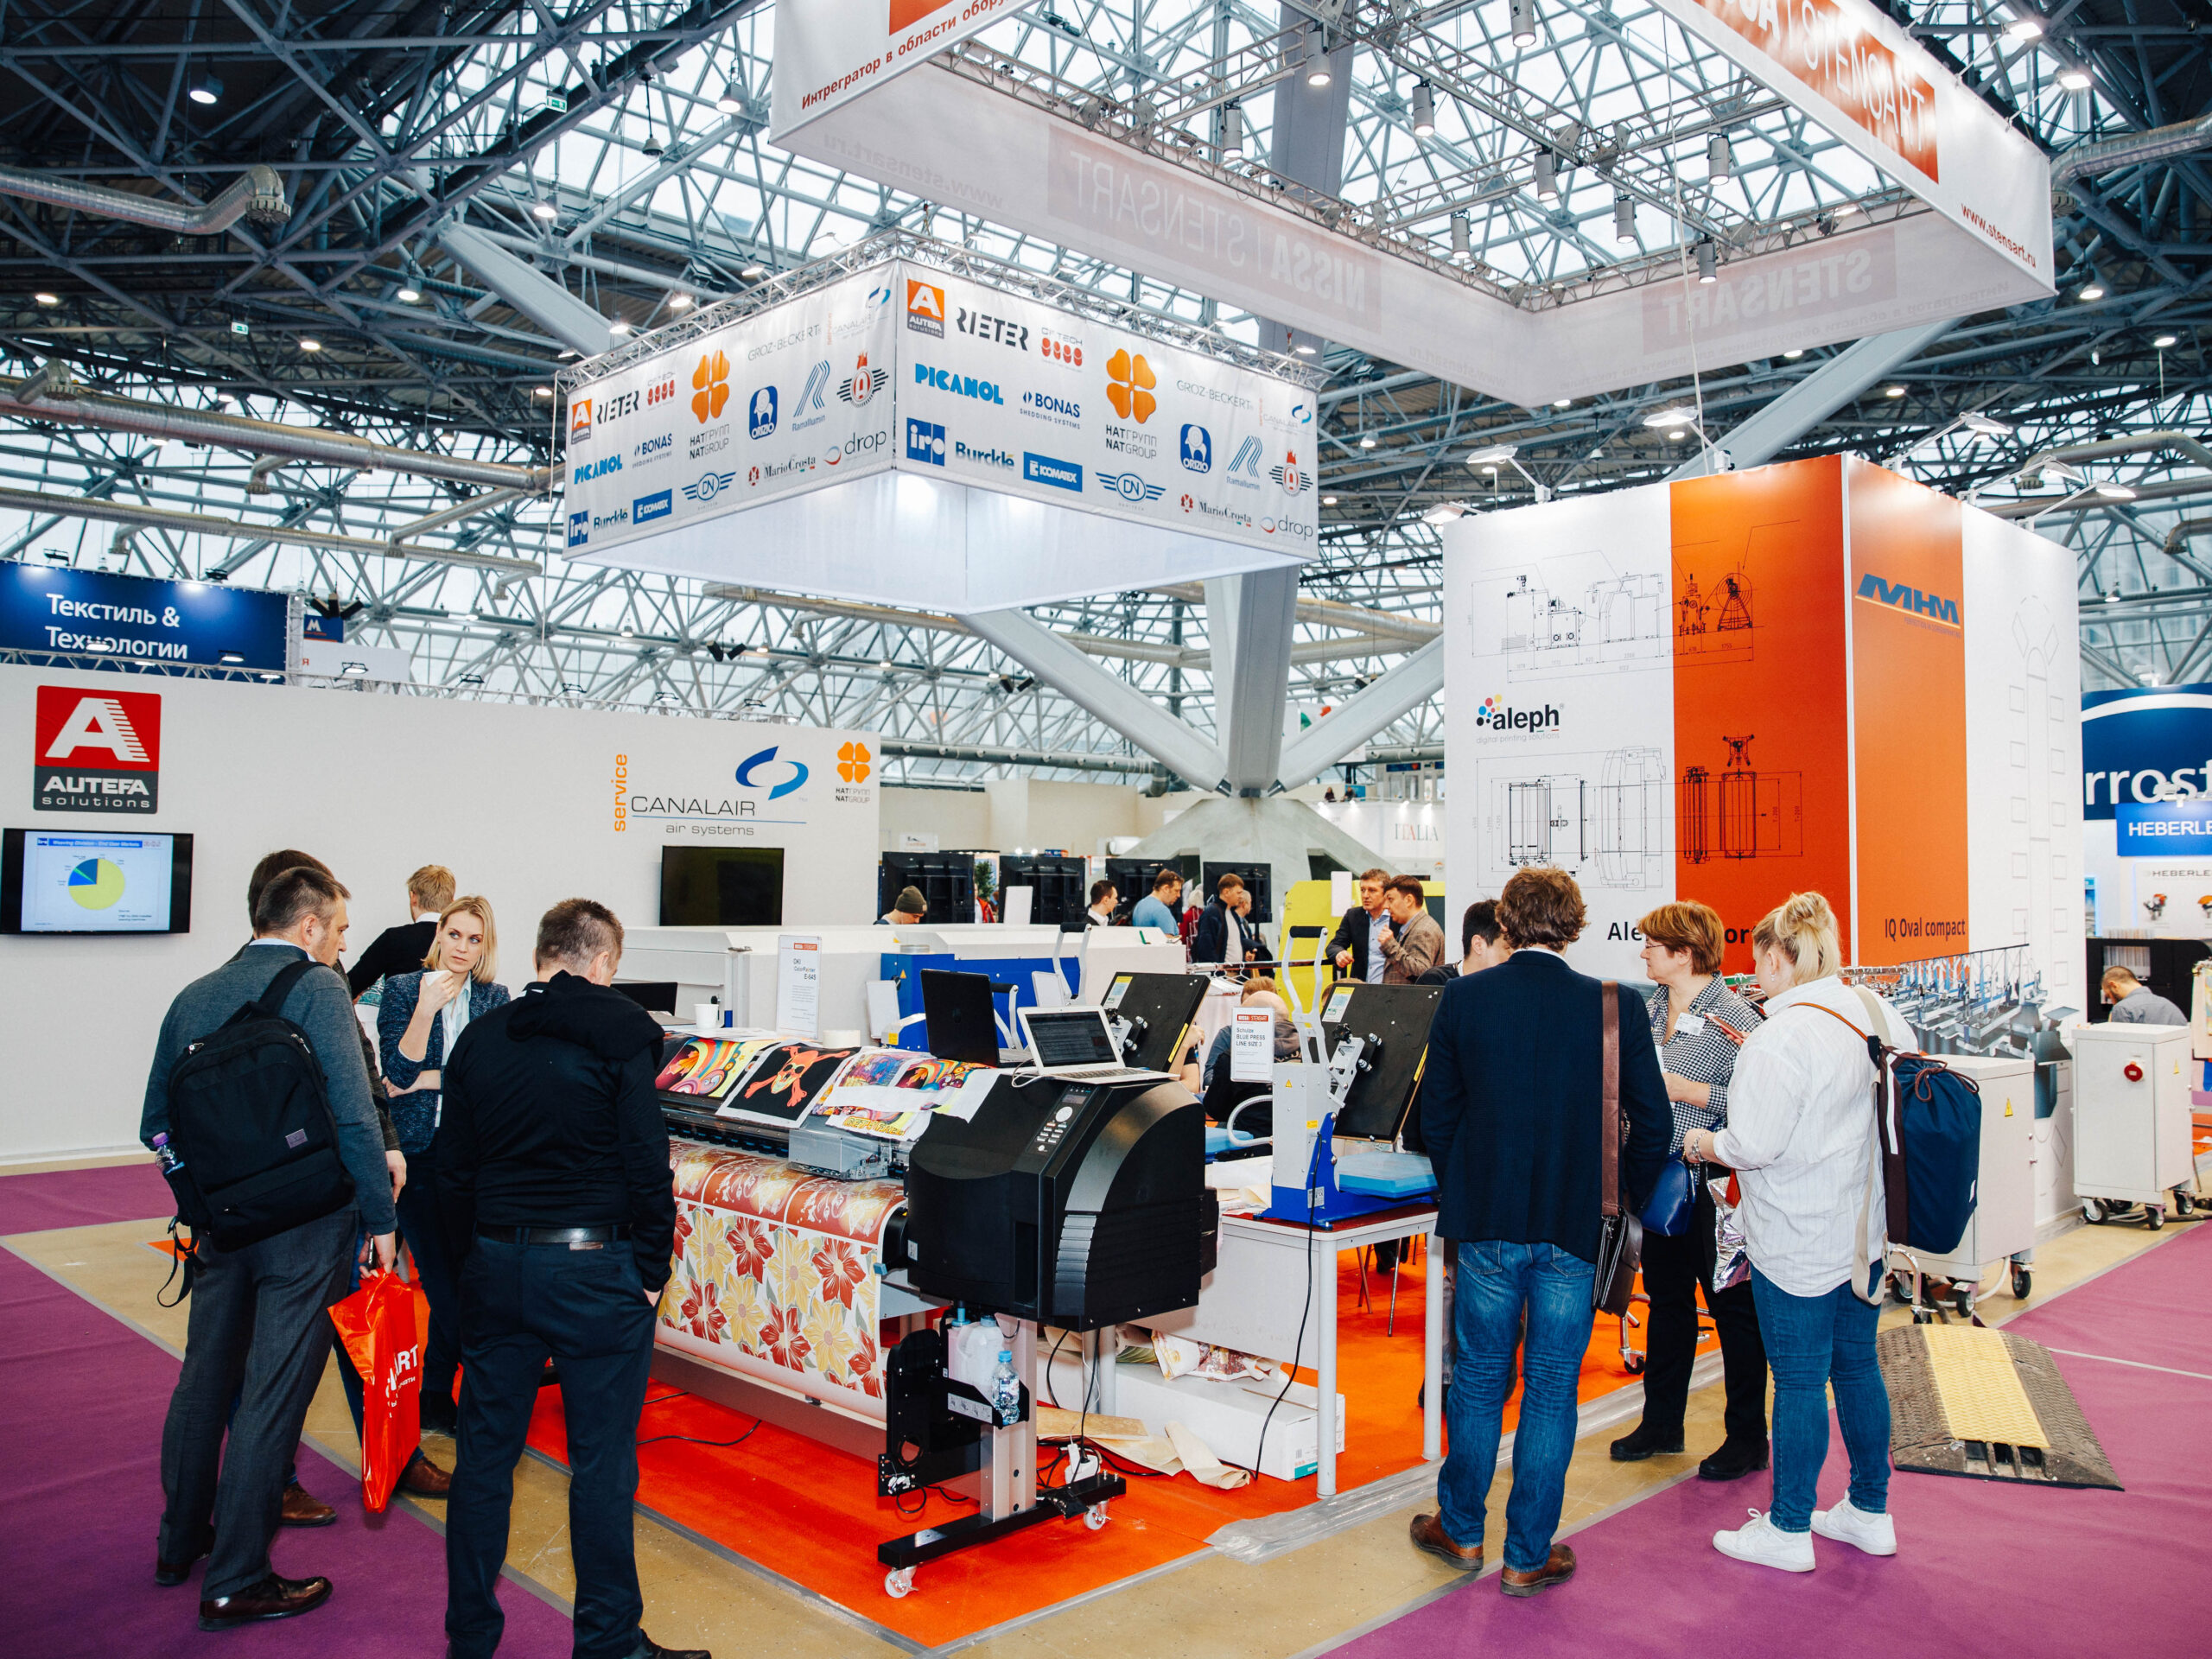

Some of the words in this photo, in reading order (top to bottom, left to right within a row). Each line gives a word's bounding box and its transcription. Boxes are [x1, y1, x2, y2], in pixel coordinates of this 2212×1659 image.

[802, 59, 880, 110] Интрегратор
[886, 52, 893, 64] в
[898, 16, 956, 56] области
[963, 0, 1009, 21] обор
[1802, 0, 1925, 152] STENSART
[1961, 203, 2037, 269] www.stensart.ru
[747, 324, 820, 361] GROZ-BECKERT
[956, 306, 1029, 352] RIETER
[915, 363, 1004, 406] PICANOL
[1176, 379, 1251, 410] GROZ-BECKERT
[597, 390, 640, 425] RIETER
[1035, 392, 1081, 418] BONAS
[642, 433, 672, 455] BONAS
[844, 430, 887, 455] drop
[574, 454, 623, 486] PICANOL
[1183, 457, 1209, 473] ORIZIO
[1278, 514, 1313, 541] drop
[46, 593, 157, 625] Текстиль
[162, 606, 181, 628] &
[1856, 573, 1960, 625] MHM
[1492, 704, 1560, 733] aleph
[1476, 735, 1497, 745] digital
[1500, 734, 1527, 744] printing
[43, 775, 149, 797] AUTEFA
[611, 753, 627, 832] service
[42, 796, 150, 809] solutions
[631, 796, 756, 817] CANALAIR
[666, 824, 686, 835] air
[691, 825, 754, 836] systems
[1607, 921, 1642, 941] Ale
[1885, 918, 1897, 942] IQ
[1900, 918, 1923, 938] Oval
[1925, 918, 1966, 945] compact
